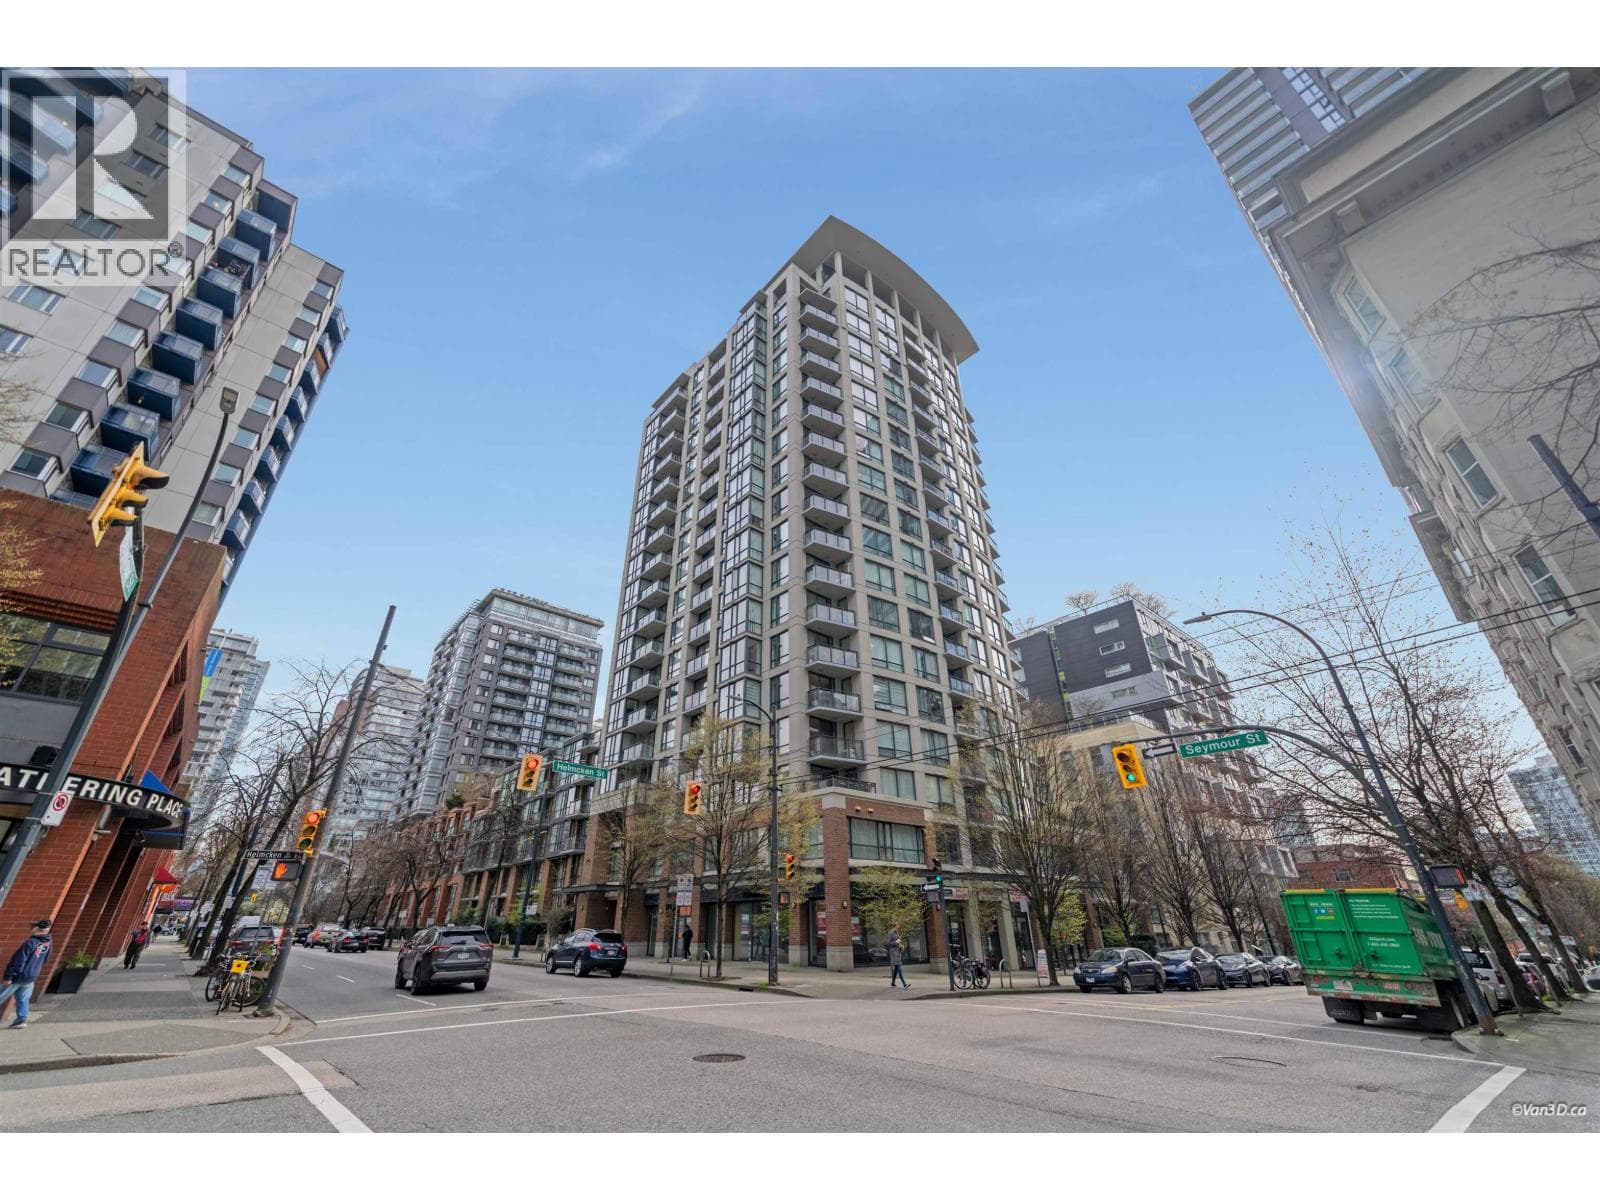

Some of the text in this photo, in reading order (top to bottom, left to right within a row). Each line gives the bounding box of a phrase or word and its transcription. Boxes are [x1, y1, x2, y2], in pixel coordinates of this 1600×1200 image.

[1185, 733, 1262, 756] Seymour St
[557, 762, 605, 777] Helmcken St
[246, 850, 282, 859] Helmcken
